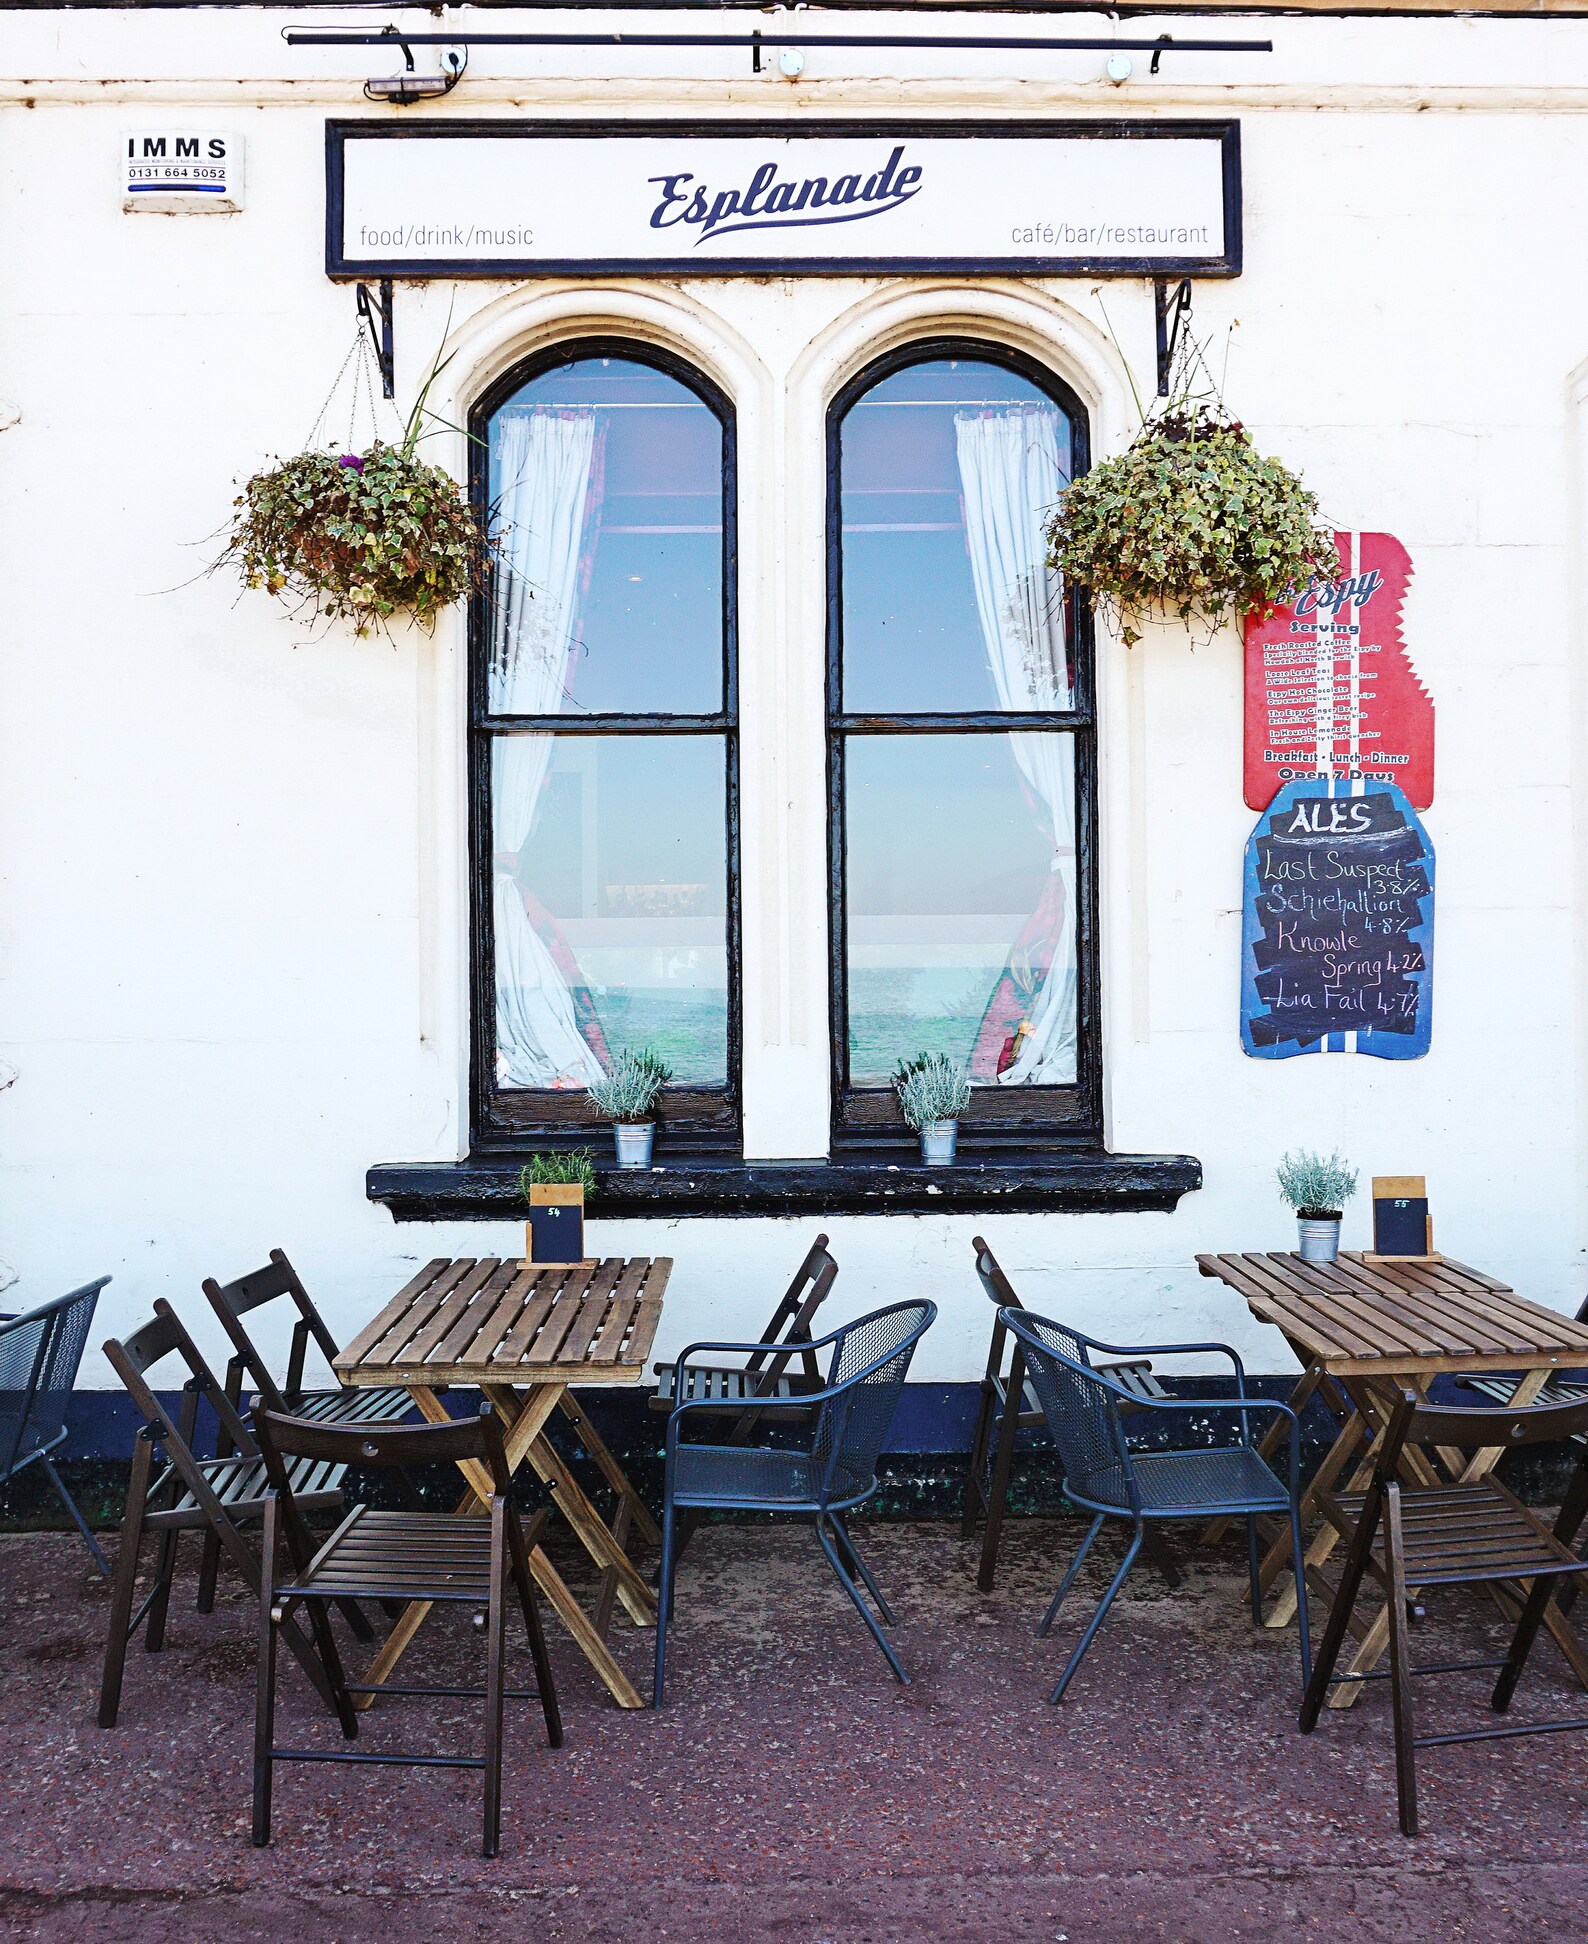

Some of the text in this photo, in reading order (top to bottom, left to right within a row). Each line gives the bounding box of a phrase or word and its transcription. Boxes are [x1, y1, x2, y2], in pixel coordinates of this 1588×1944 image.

[129, 138, 226, 158] IMMS
[129, 168, 225, 178] 0131 664 5052
[648, 146, 922, 234] Esplanade
[360, 225, 533, 248] food/drink/music
[1012, 223, 1208, 245] café/bar/restaurant
[1290, 621, 1360, 634] Serving
[1265, 650, 1296, 658] Specially
[1309, 726, 1351, 734] Lemonade
[1264, 751, 1318, 762] Breakfast
[1329, 751, 1361, 763] Lunch
[1372, 753, 1408, 763] Dinner
[1278, 768, 1395, 780] Open 7 Days
[1288, 803, 1374, 834] ALES
[1264, 849, 1404, 888] Last Suspect
[1266, 884, 1405, 925] Schiehallion
[1278, 921, 1362, 953] Knowle
[1321, 954, 1381, 987] Spring
[1324, 985, 1366, 1011] Fail
[548, 1207, 561, 1217] 54
[1394, 1200, 1411, 1208] 55
